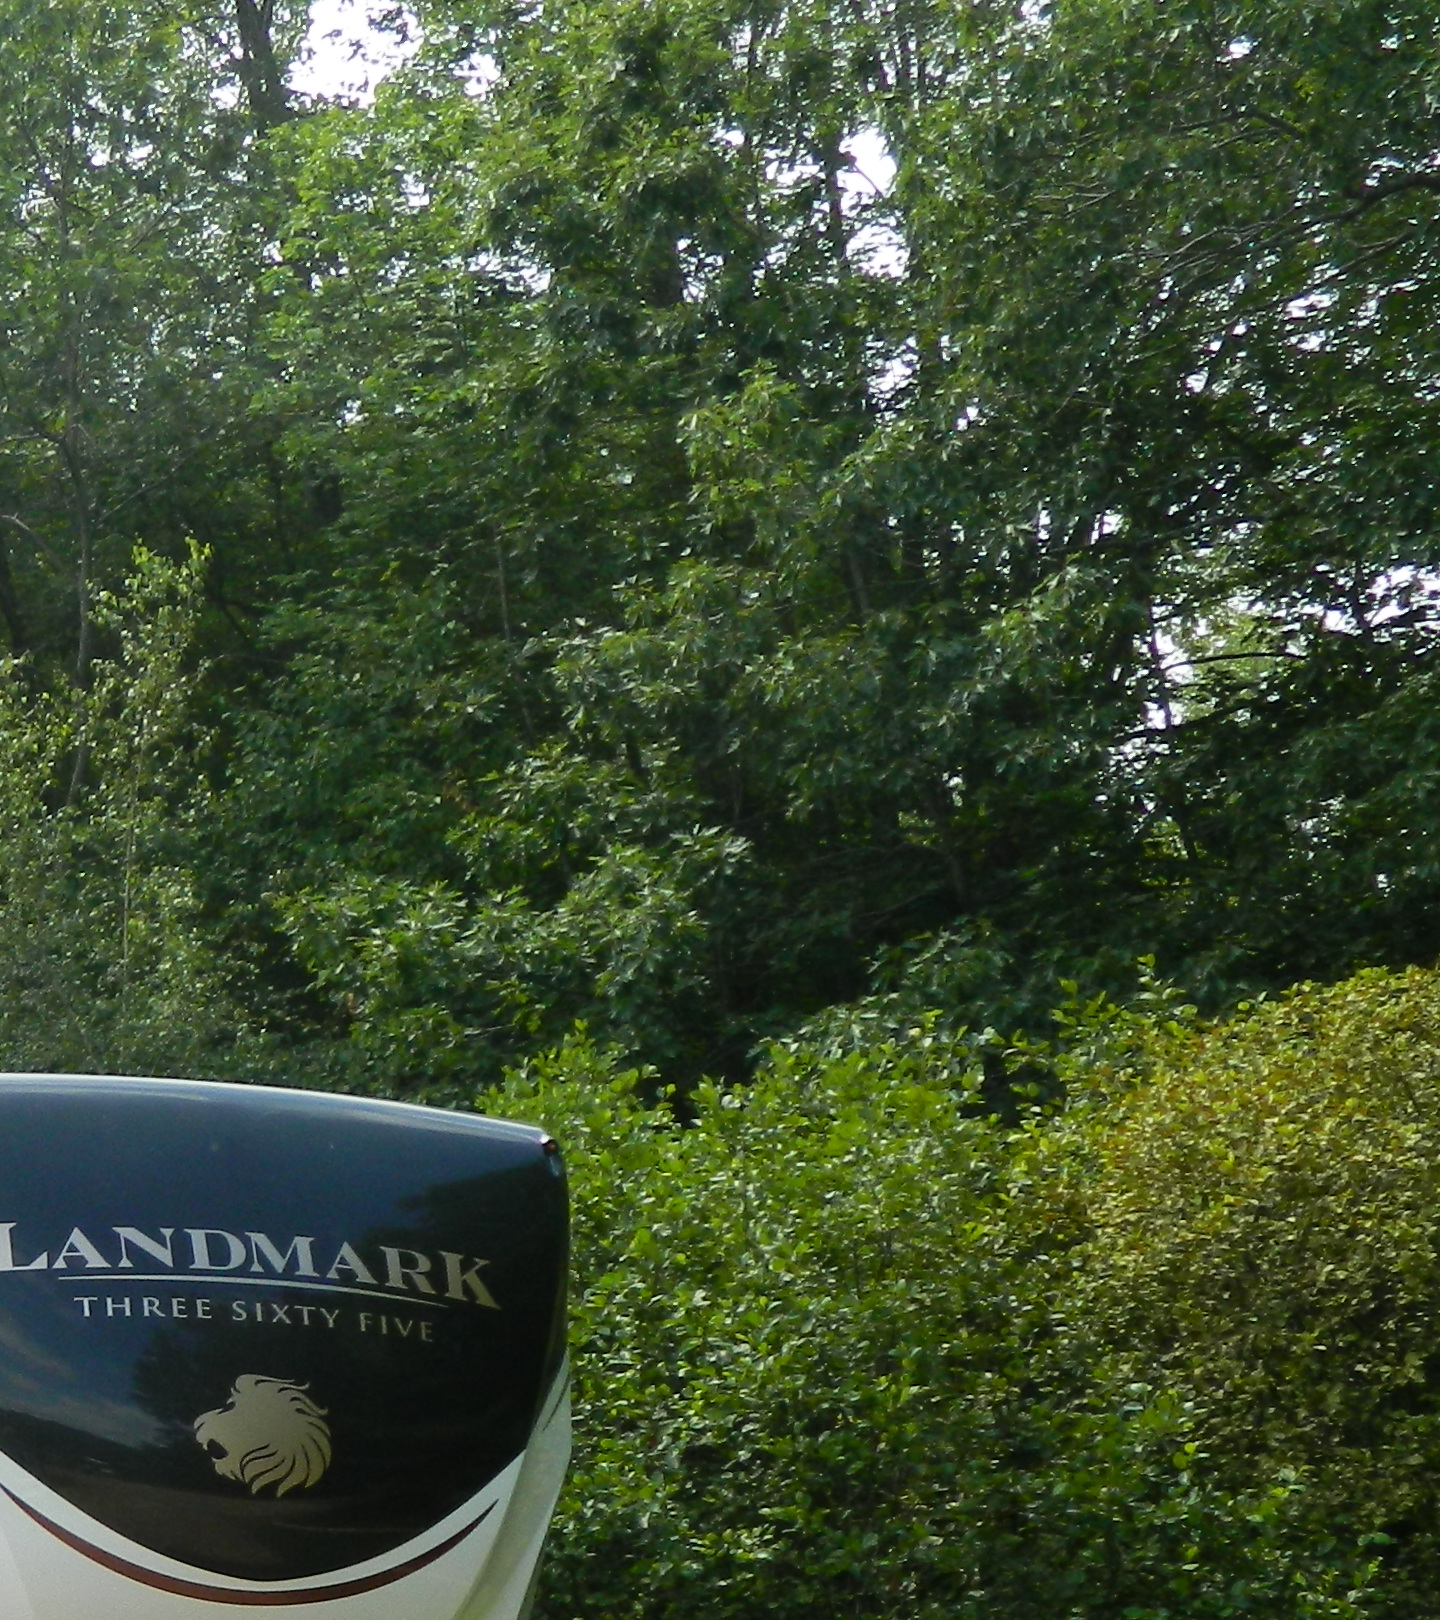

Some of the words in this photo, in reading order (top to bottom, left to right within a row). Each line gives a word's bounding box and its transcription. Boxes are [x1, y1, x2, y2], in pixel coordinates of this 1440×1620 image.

[73, 1296, 213, 1319] THREE
[231, 1300, 340, 1329] SIXTY
[358, 1311, 434, 1343] FIVE
